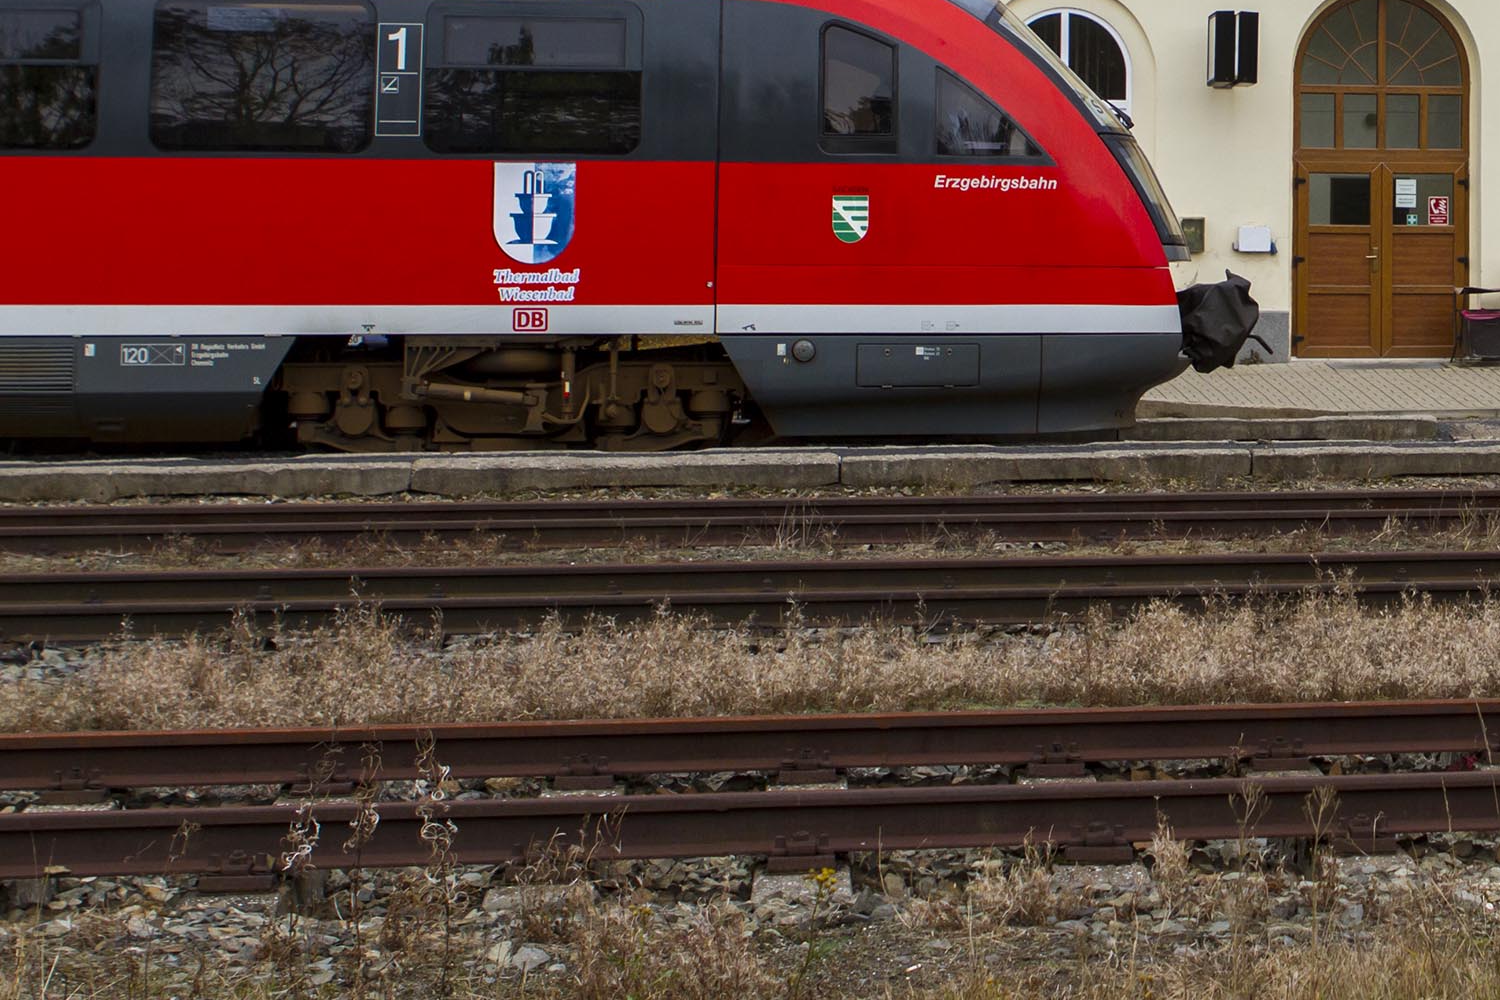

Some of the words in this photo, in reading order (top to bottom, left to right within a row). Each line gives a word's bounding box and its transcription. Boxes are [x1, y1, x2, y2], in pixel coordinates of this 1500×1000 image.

[388, 27, 407, 71] 1
[934, 175, 1058, 192] Erzgebirgsbahn
[493, 268, 581, 284] Thermalbad
[498, 286, 575, 302] Wiesenbad
[517, 311, 545, 328] DB
[122, 347, 149, 364] 120
